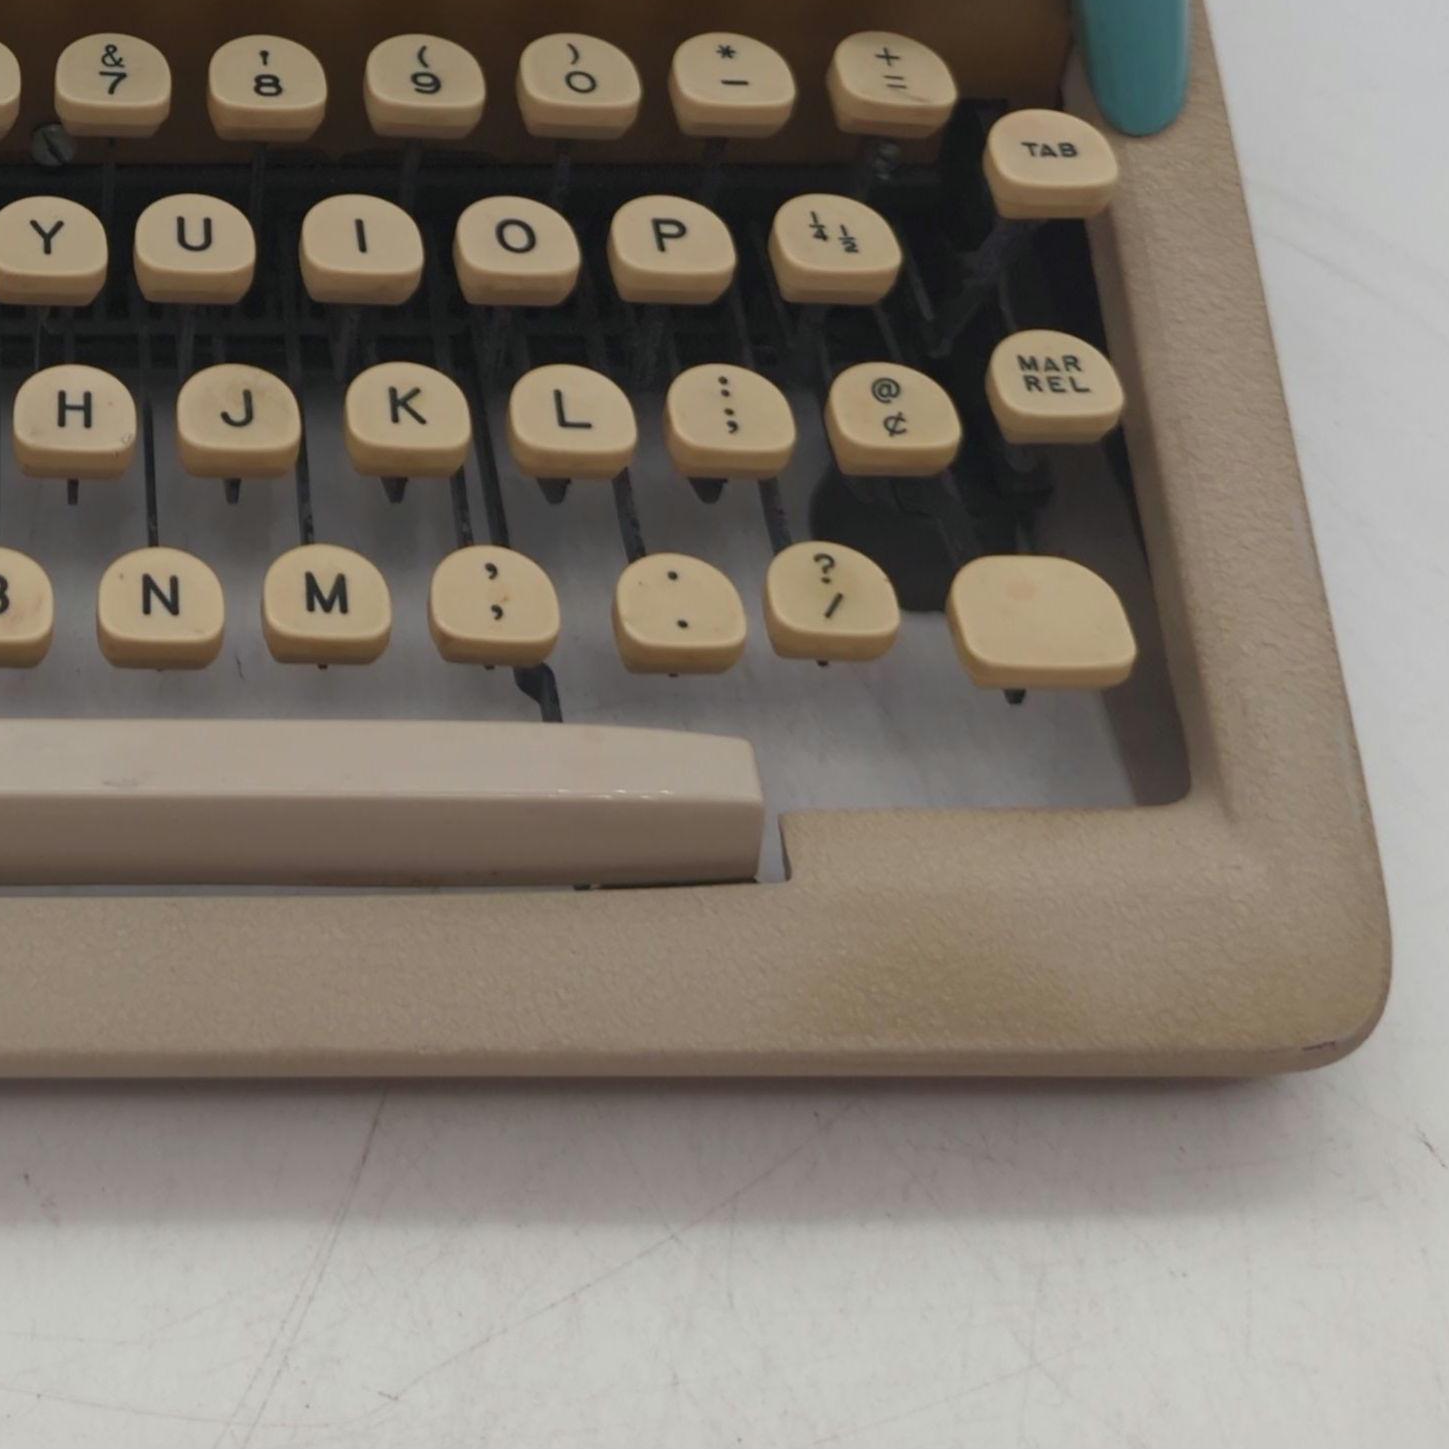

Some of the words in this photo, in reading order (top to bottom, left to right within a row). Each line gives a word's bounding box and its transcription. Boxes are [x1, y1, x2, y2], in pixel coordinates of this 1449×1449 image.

[100, 44, 124, 67] &
[417, 46, 429, 68] (
[567, 43, 580, 65] )
[875, 47, 900, 66] +
[99, 71, 127, 95] 7
[254, 74, 283, 97] 8
[411, 70, 441, 94] 9
[1021, 142, 1078, 158] TAB
[30, 220, 64, 255] Y
[177, 216, 212, 252] U
[355, 219, 367, 253] I
[495, 219, 536, 254] O
[652, 218, 687, 252] P
[1017, 355, 1082, 375] MAR
[718, 376, 730, 397] :
[871, 378, 901, 404] @
[1024, 375, 1091, 394] REL
[57, 390, 92, 429] H
[221, 389, 254, 428] J
[389, 387, 426, 425] K
[554, 389, 592, 429] L
[724, 408, 738, 434] ;
[814, 553, 835, 584] ?
[142, 574, 179, 616] N
[305, 572, 348, 614] M
